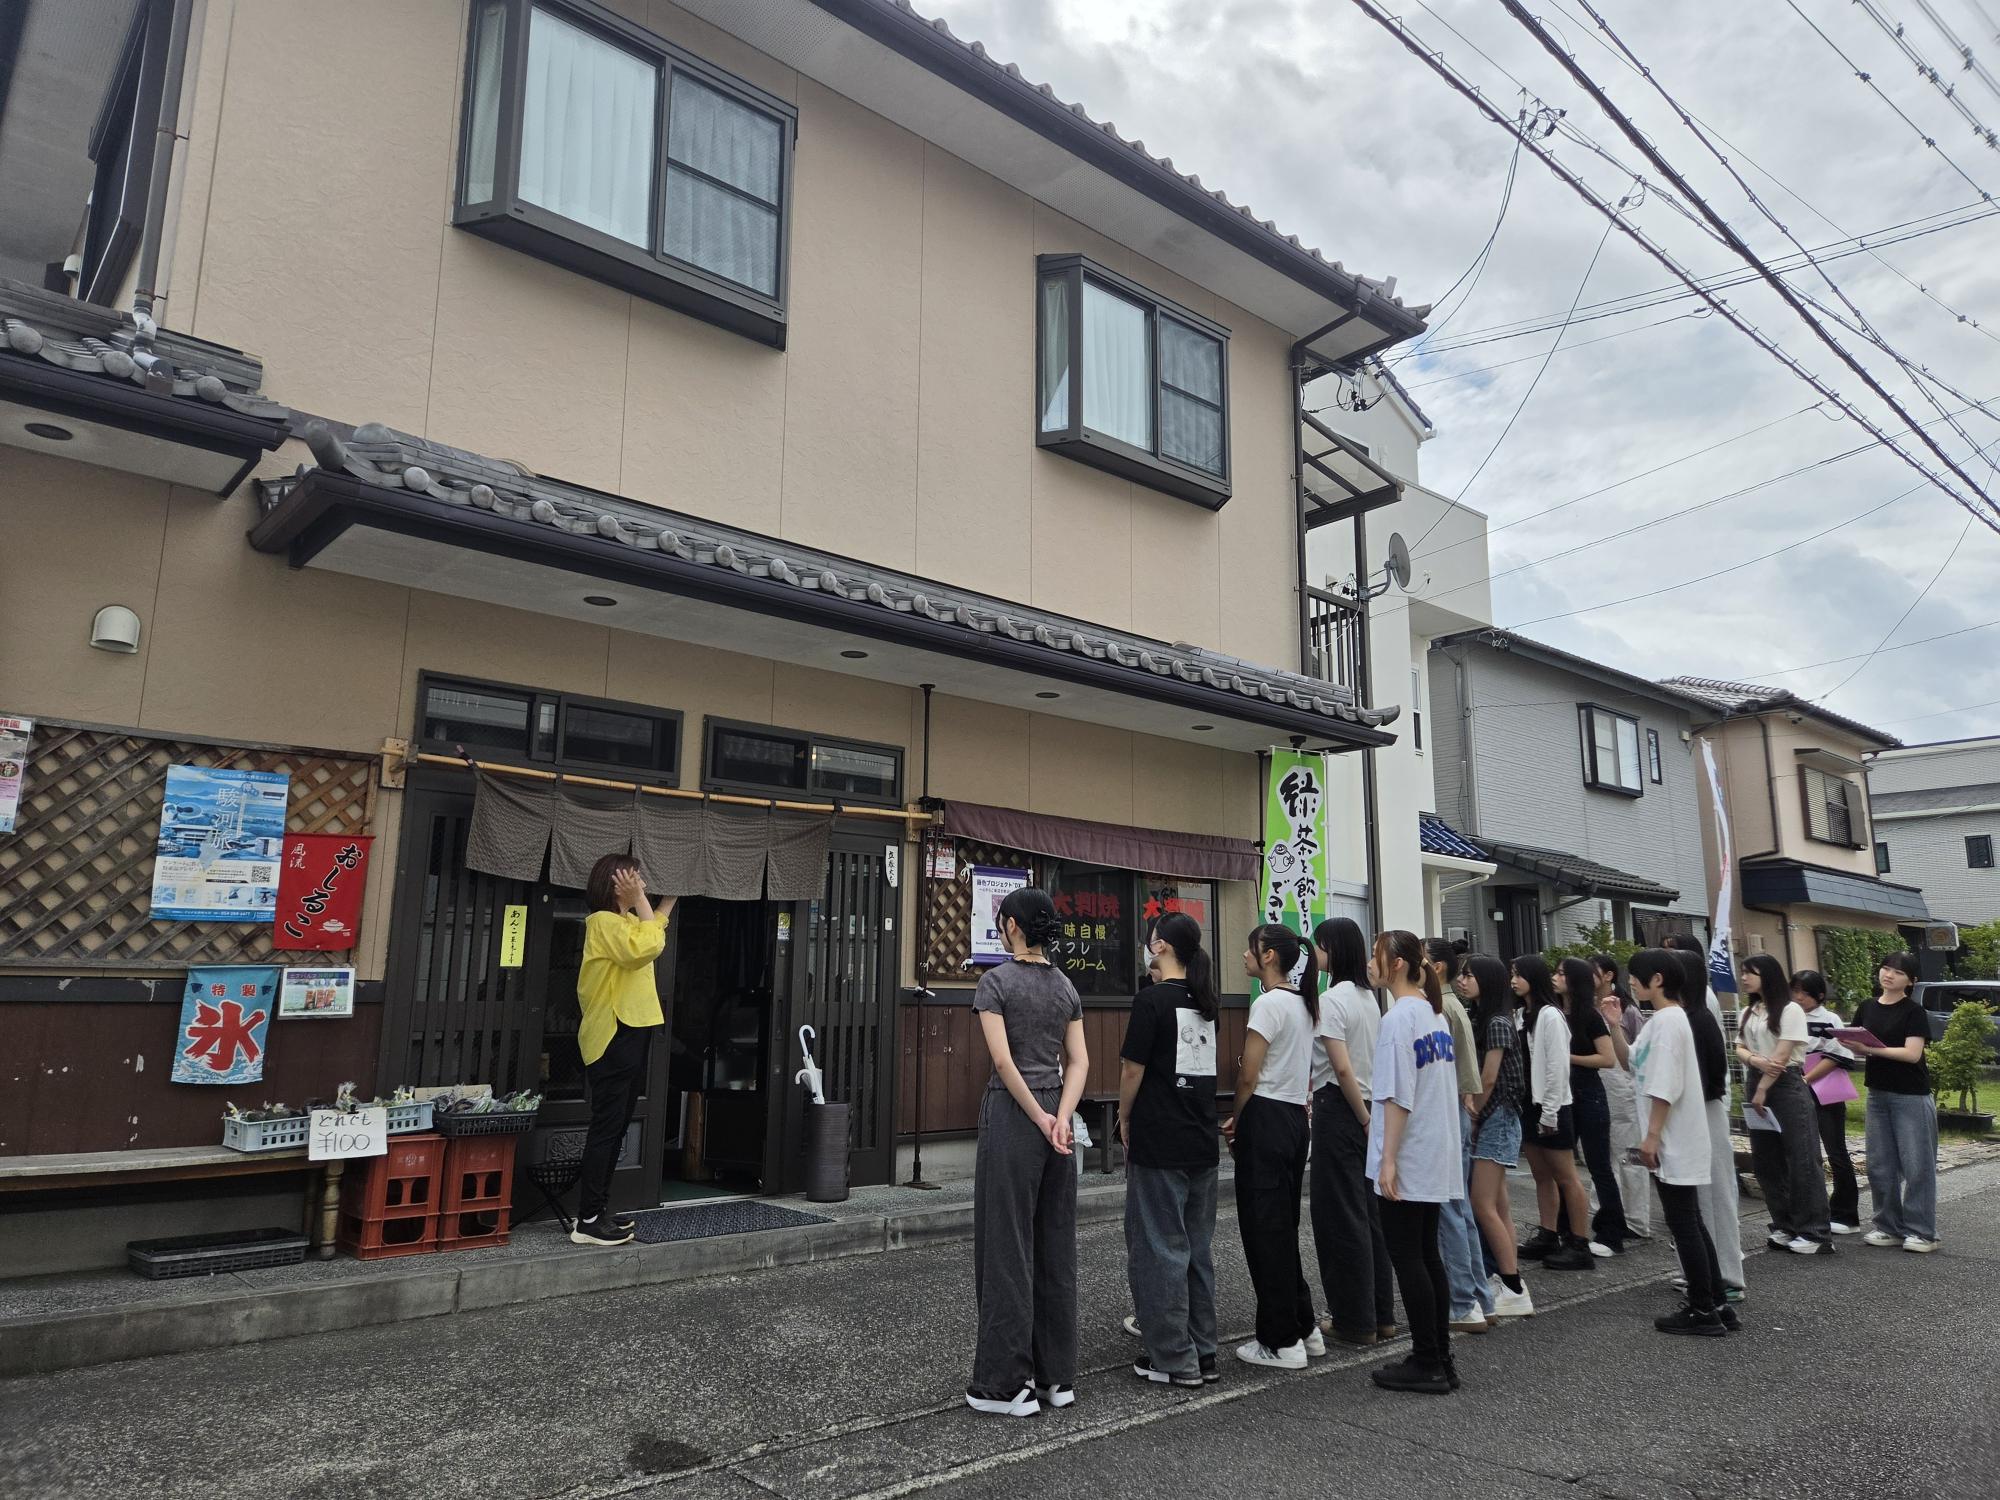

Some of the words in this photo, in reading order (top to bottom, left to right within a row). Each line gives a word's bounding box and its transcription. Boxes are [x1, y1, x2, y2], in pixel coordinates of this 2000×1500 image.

[209, 787, 241, 850] 駿河旅
[289, 843, 306, 870] 風流
[1280, 771, 1320, 935] 緑茶を飲もう
[284, 843, 364, 939] おしるこ
[1063, 922, 1107, 941] 味自慢
[1065, 957, 1107, 972] クリーム
[211, 983, 257, 998] 特製
[182, 999, 267, 1073] 氷
[317, 1131, 372, 1153] ¥100
